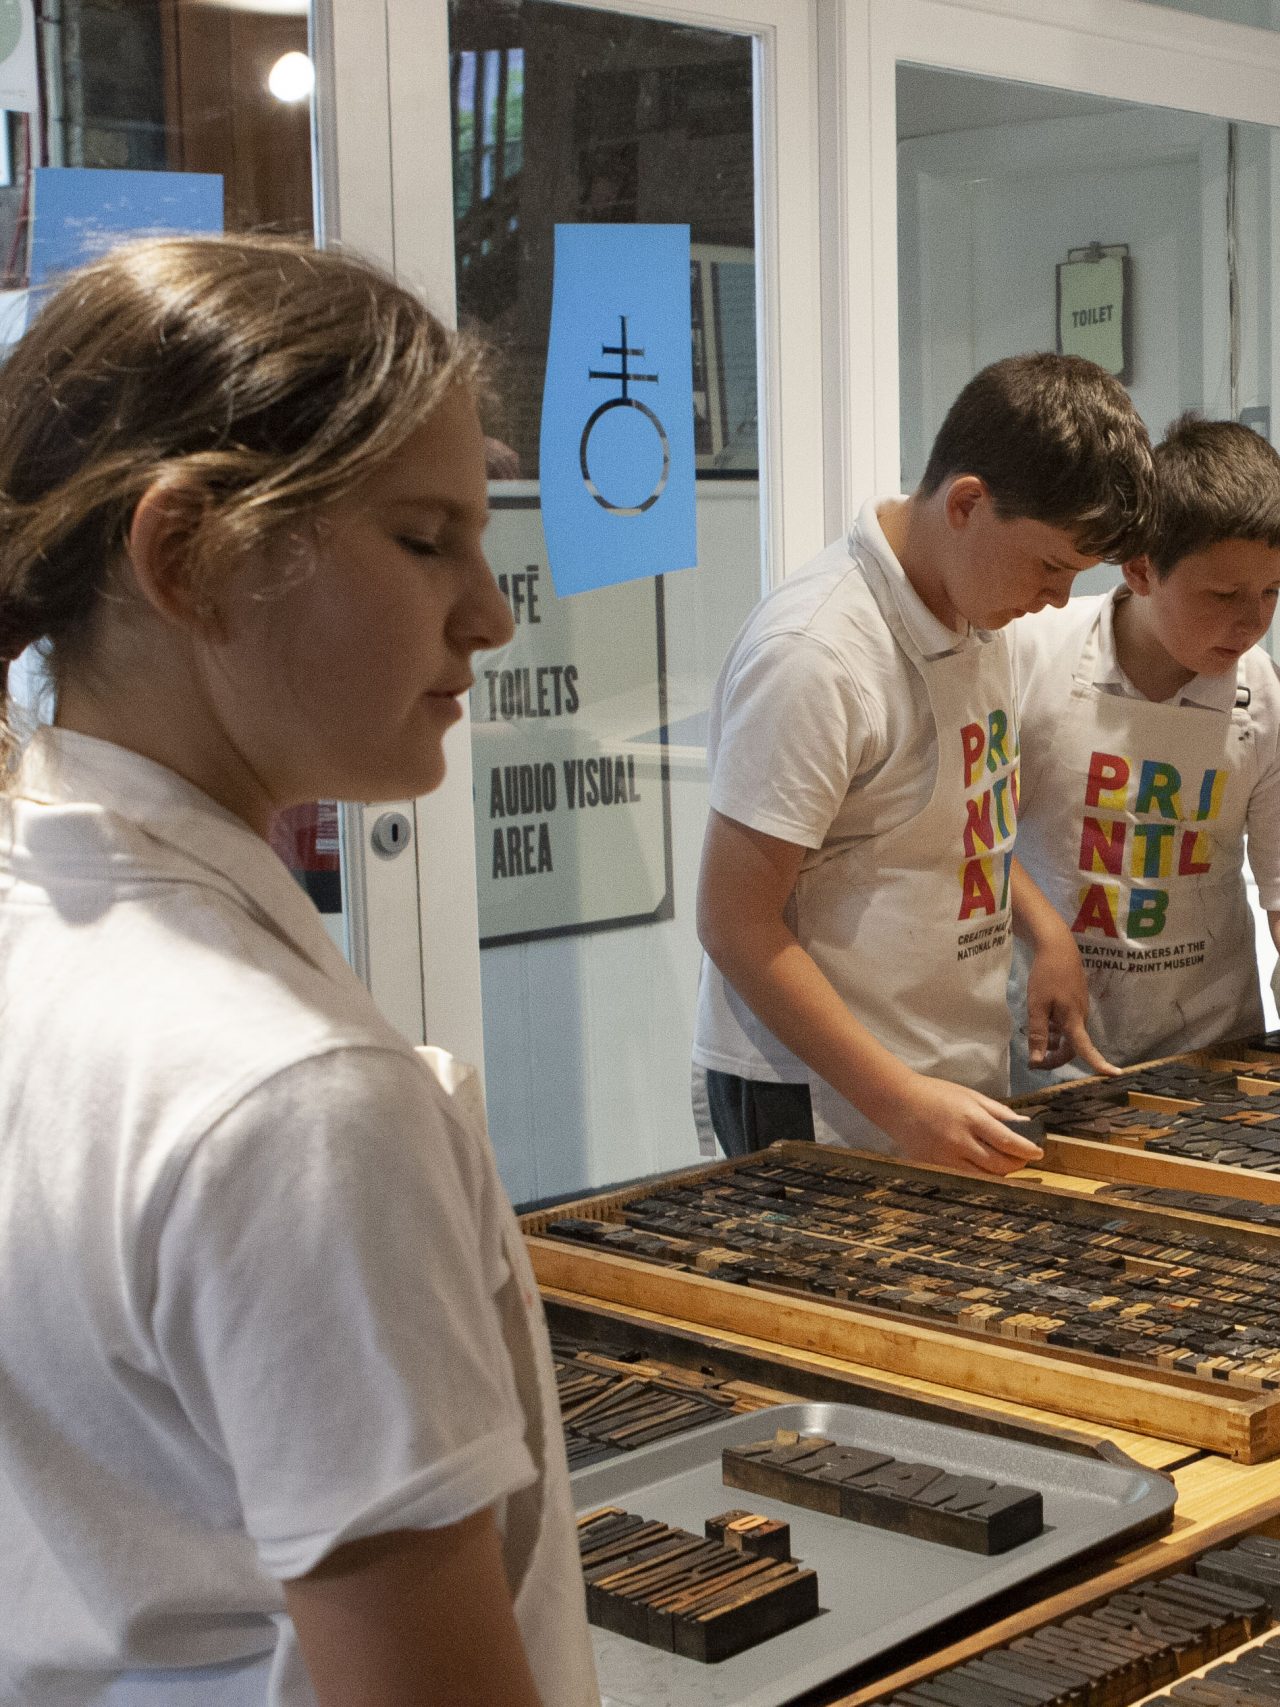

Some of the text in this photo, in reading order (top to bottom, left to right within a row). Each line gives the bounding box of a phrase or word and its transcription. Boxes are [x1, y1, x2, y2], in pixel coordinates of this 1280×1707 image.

[1072, 304, 1113, 328] TOILET
[484, 665, 579, 721] TOILETS
[490, 754, 641, 819] AUDIO VISUAL
[1085, 751, 1229, 821] PRI
[492, 822, 553, 879] AREA
[1079, 816, 1212, 878] NTL
[1071, 884, 1169, 939] AB
[957, 941, 991, 961] NATIONAL
[1078, 940, 1206, 960] REATIVE MAKERS AT THE
[1127, 962, 1162, 973] PRINT
[1164, 955, 1205, 971] MUSEUM
